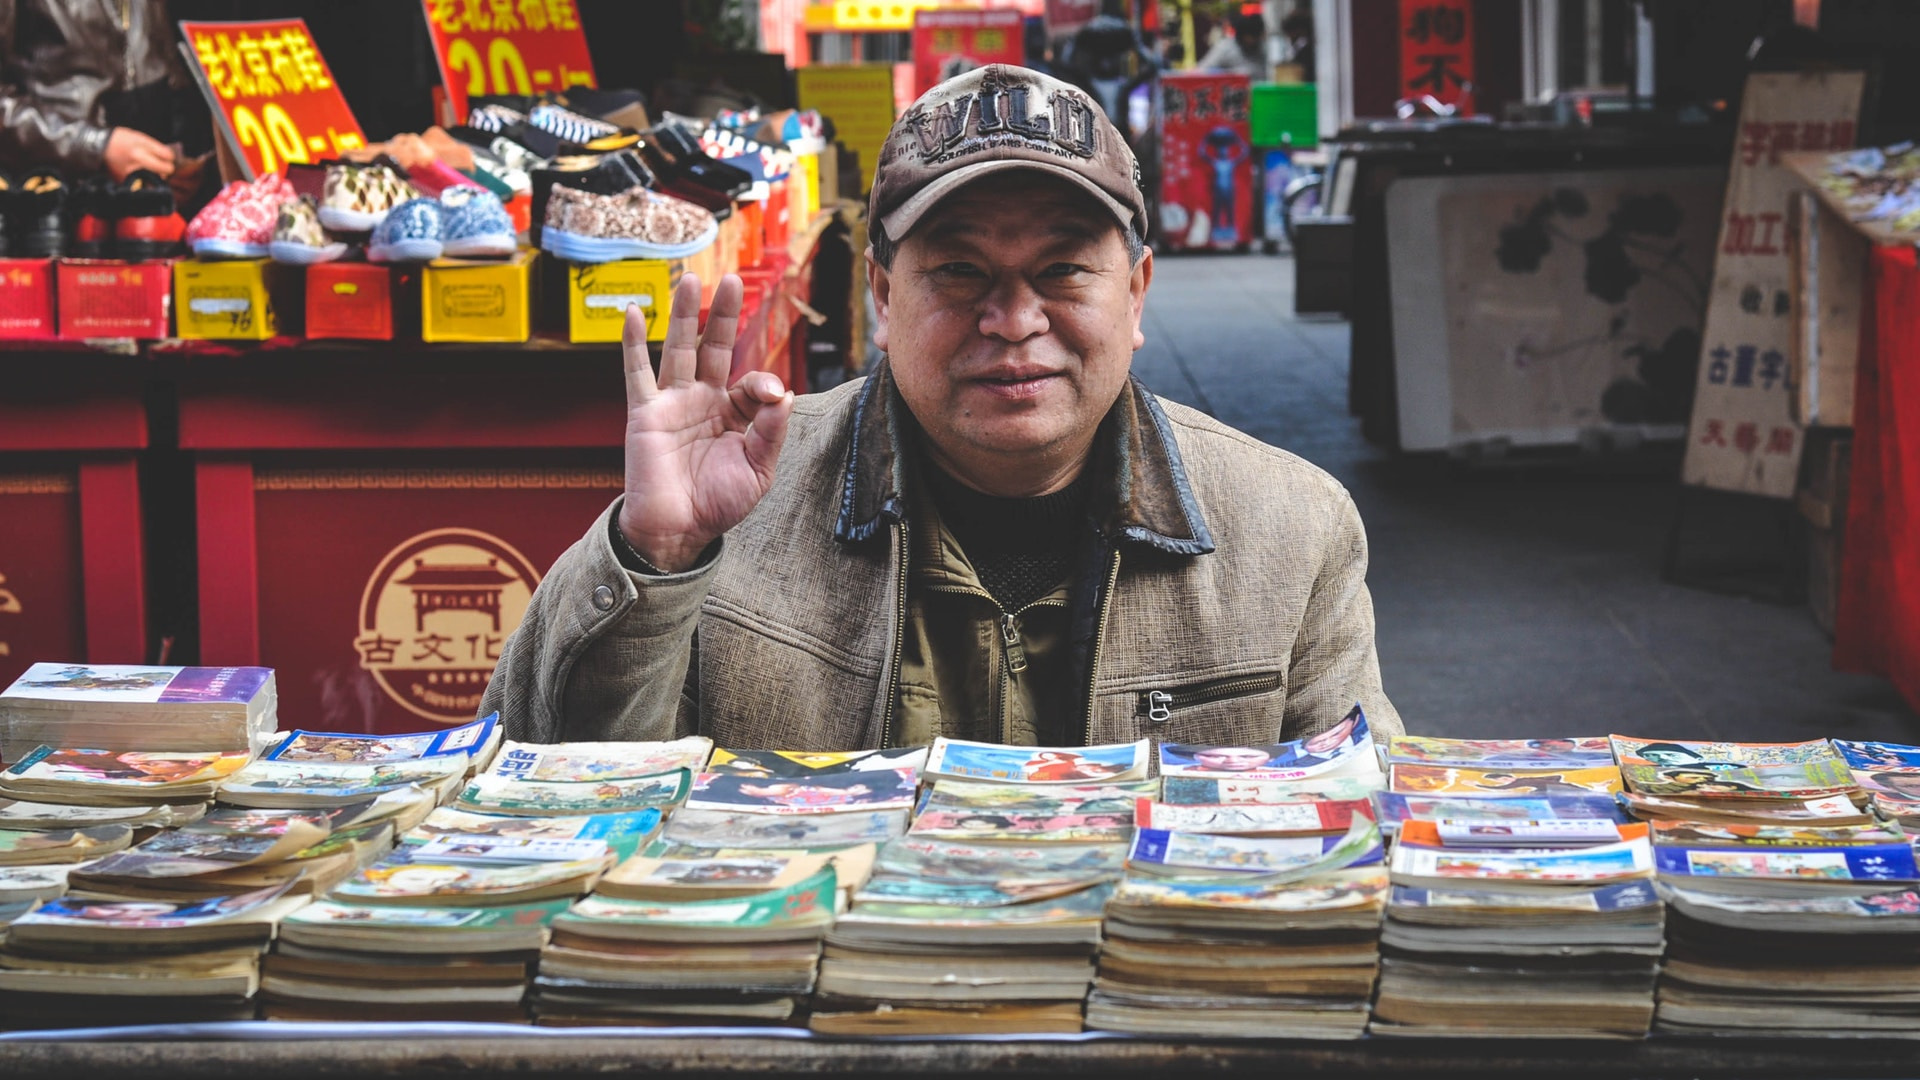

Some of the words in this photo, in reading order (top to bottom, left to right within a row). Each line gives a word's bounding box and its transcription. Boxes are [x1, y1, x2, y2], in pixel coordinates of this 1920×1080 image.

[196, 28, 333, 99] 老北京布鞋
[907, 85, 1095, 162] WILD
[1024, 141, 1074, 160] COMPANY
[1722, 210, 1791, 255] 加工
[1708, 344, 1792, 390] 古董字
[358, 634, 503, 663] 古文化
